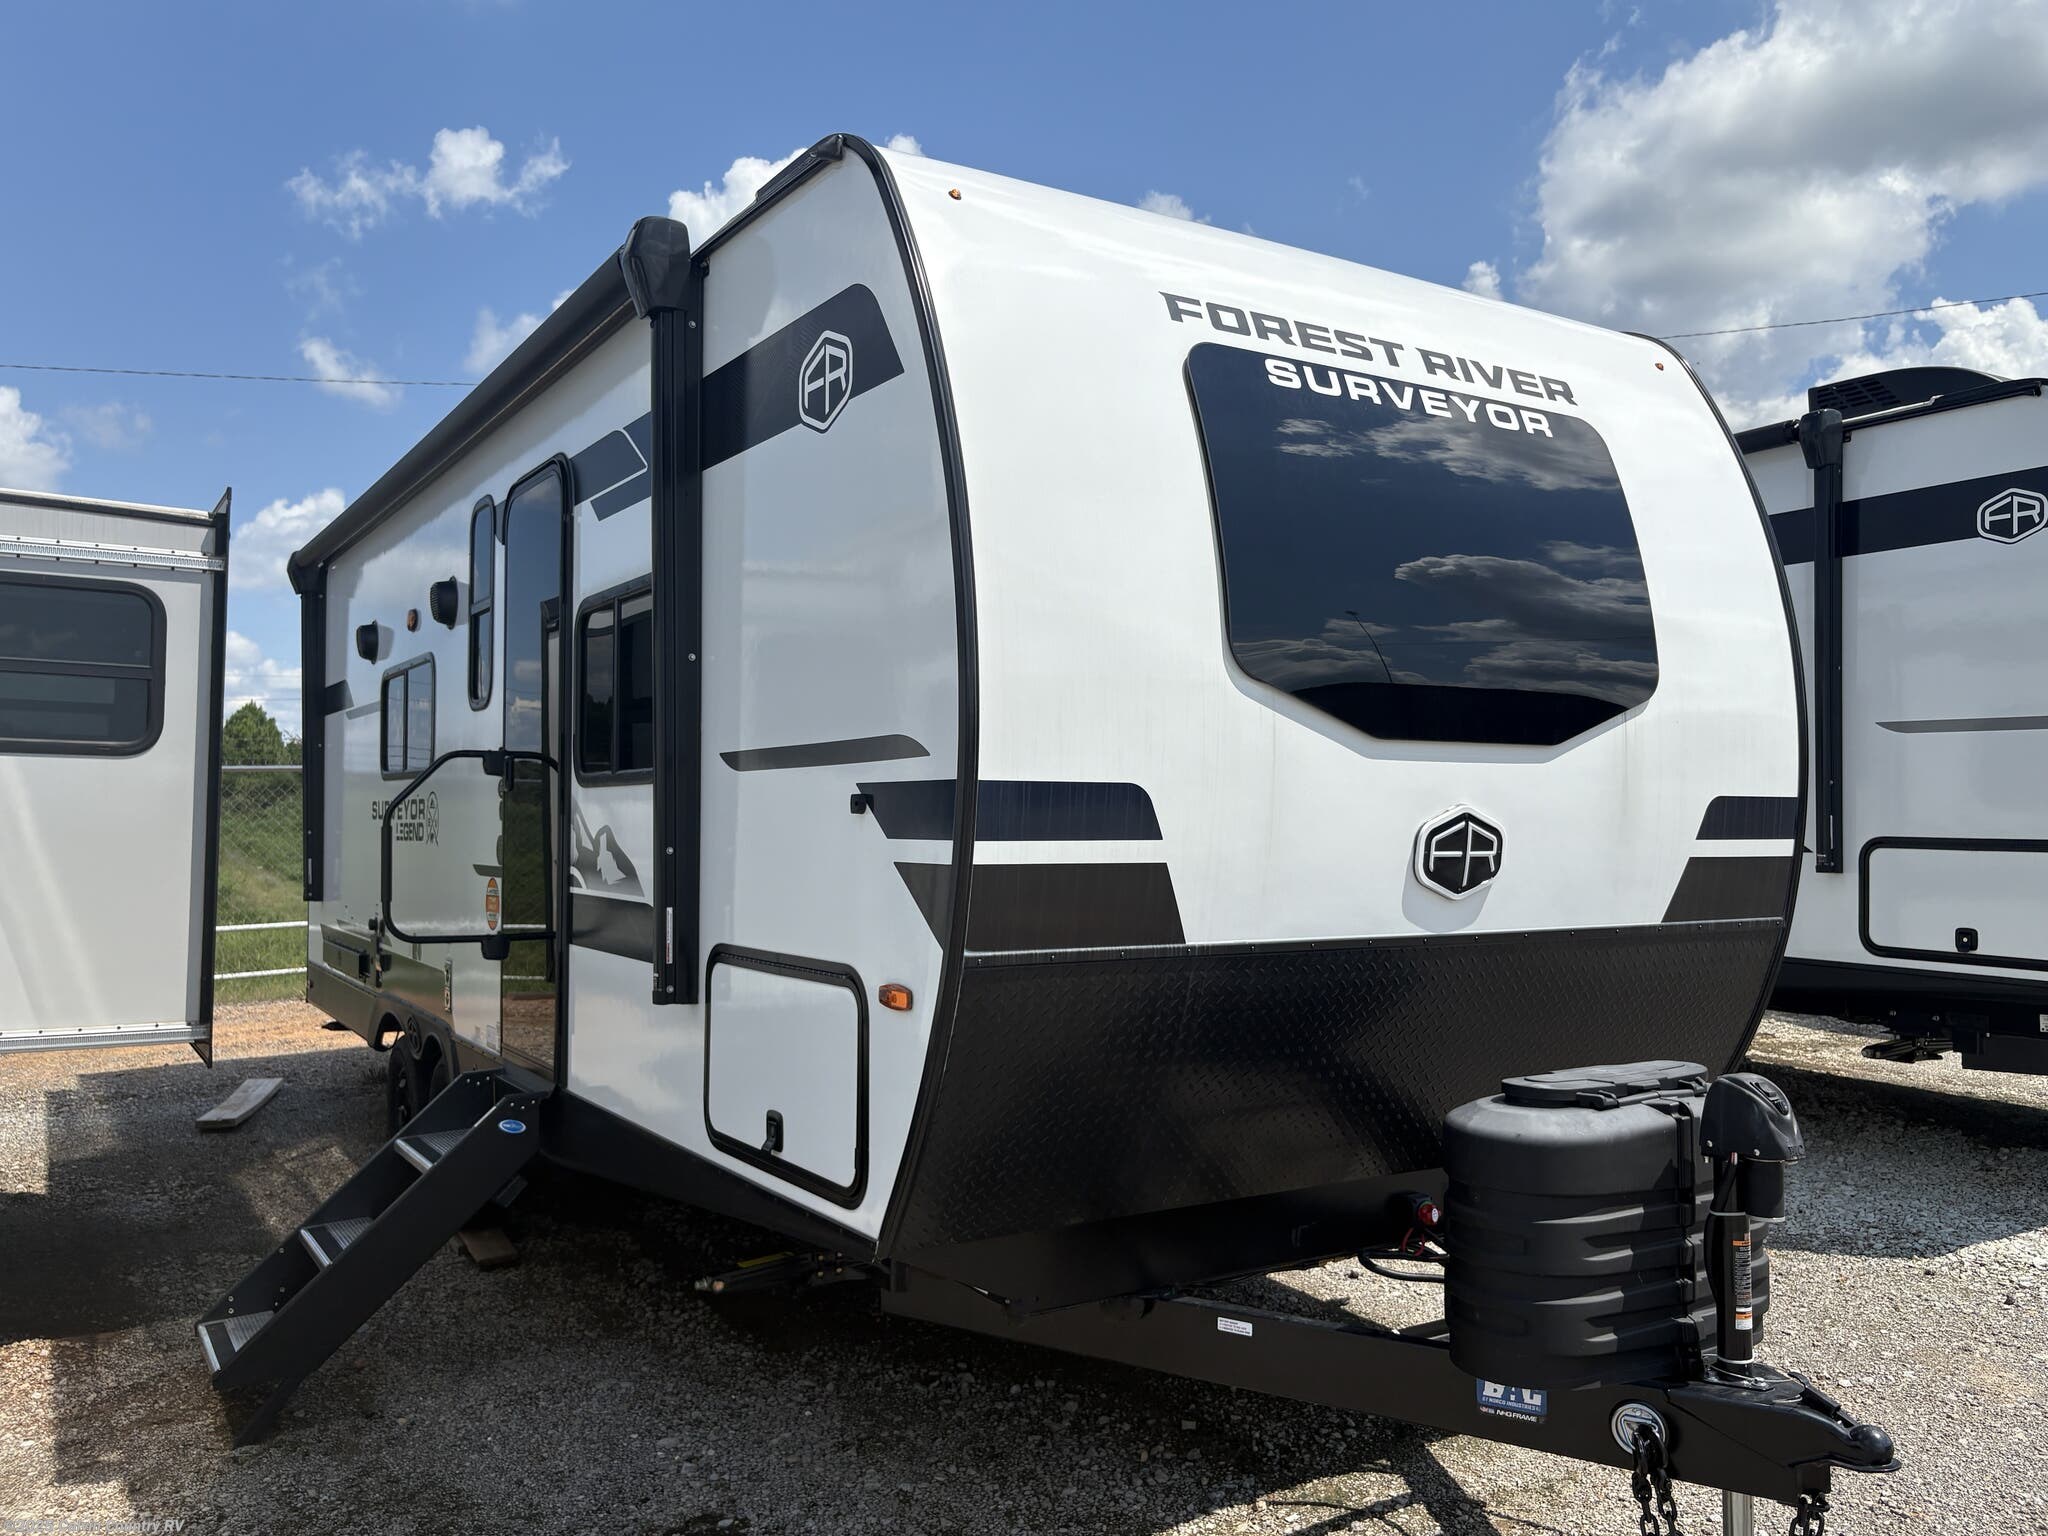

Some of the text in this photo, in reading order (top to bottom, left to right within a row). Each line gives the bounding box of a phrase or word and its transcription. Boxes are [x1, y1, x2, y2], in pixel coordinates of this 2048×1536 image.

[1158, 290, 1579, 407] FOREST RIVER
[1264, 358, 1553, 438] SURVEYOR
[1984, 495, 2041, 535] FR
[372, 798, 426, 820] SUEYOR
[396, 822, 425, 841] LEGEND
[1513, 1412, 1538, 1422] FRAME
